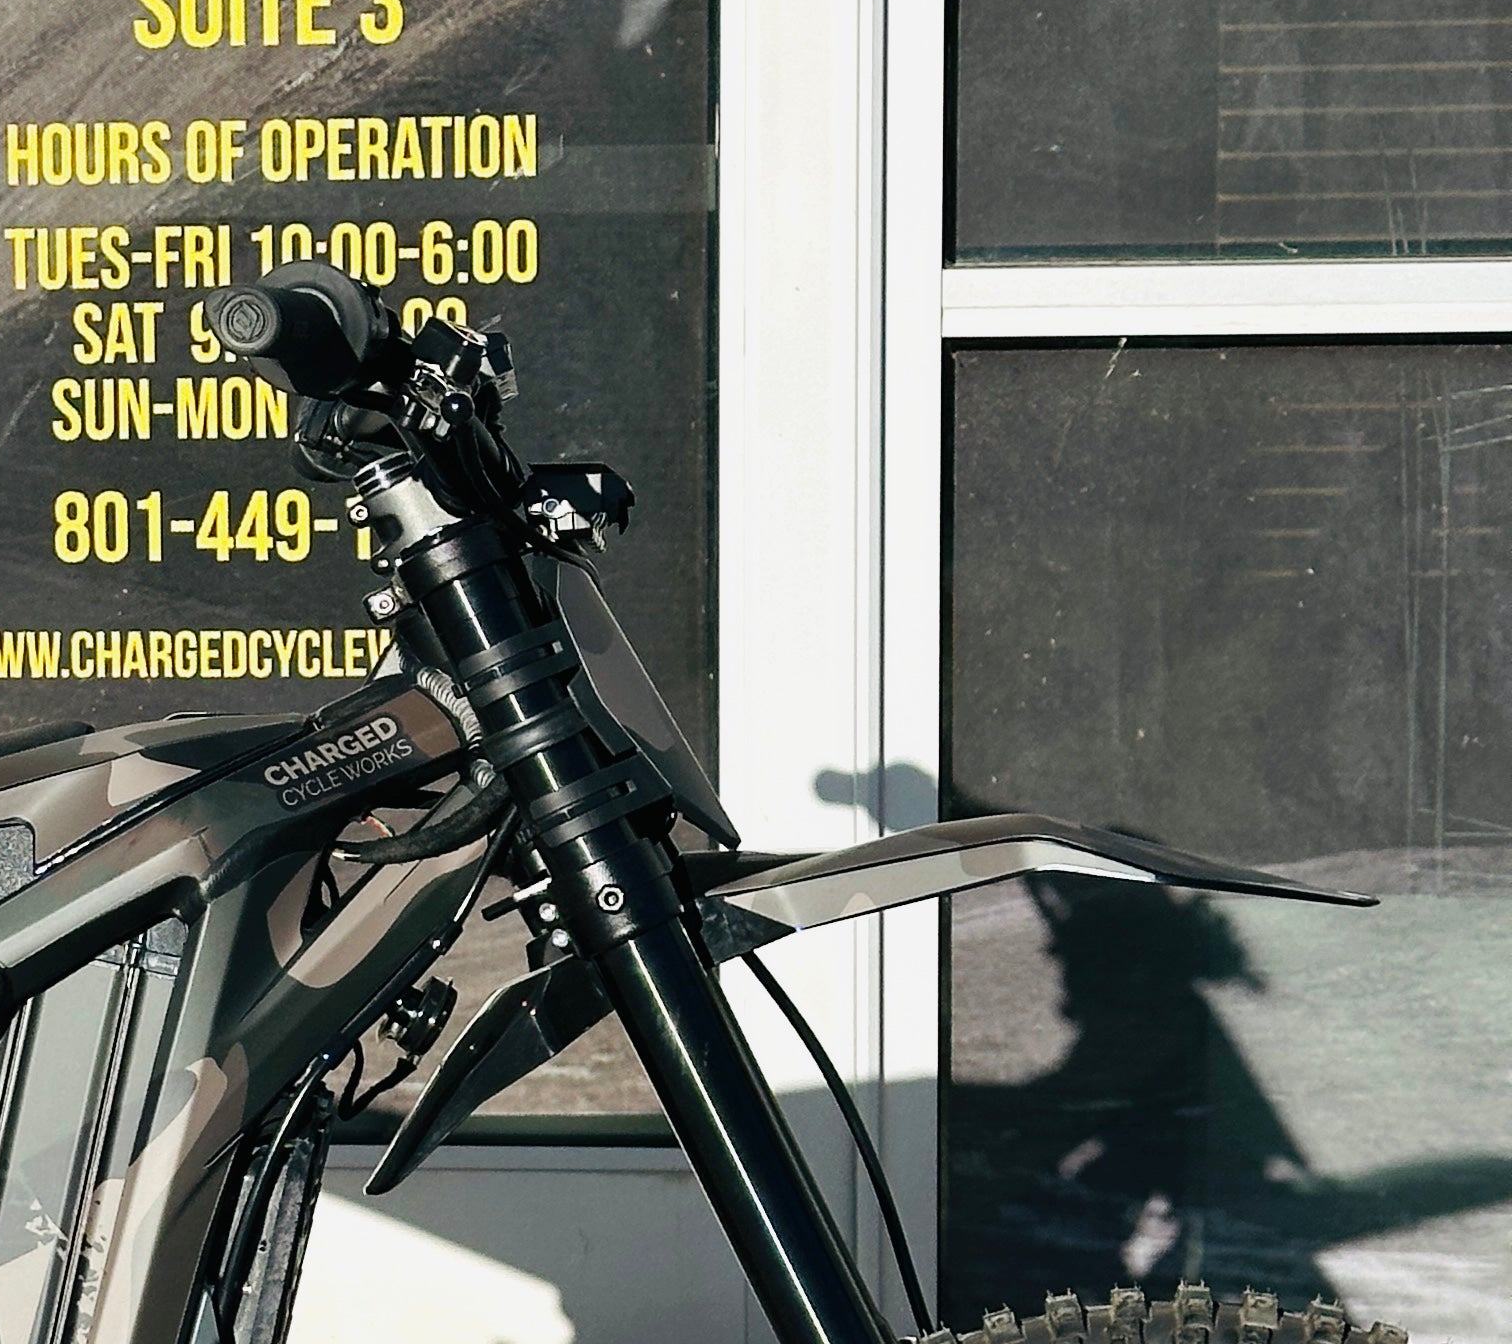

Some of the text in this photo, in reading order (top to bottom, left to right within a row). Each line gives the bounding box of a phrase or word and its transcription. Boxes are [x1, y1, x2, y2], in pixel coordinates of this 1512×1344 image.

[6, 114, 537, 186] HOURS OF OPERATION
[4, 224, 231, 291] TUES-FRI
[73, 302, 163, 365] SAT
[51, 377, 289, 442] SUN-MON
[264, 717, 398, 786] CHARGED
[282, 738, 413, 806] CYCLE WORKS
